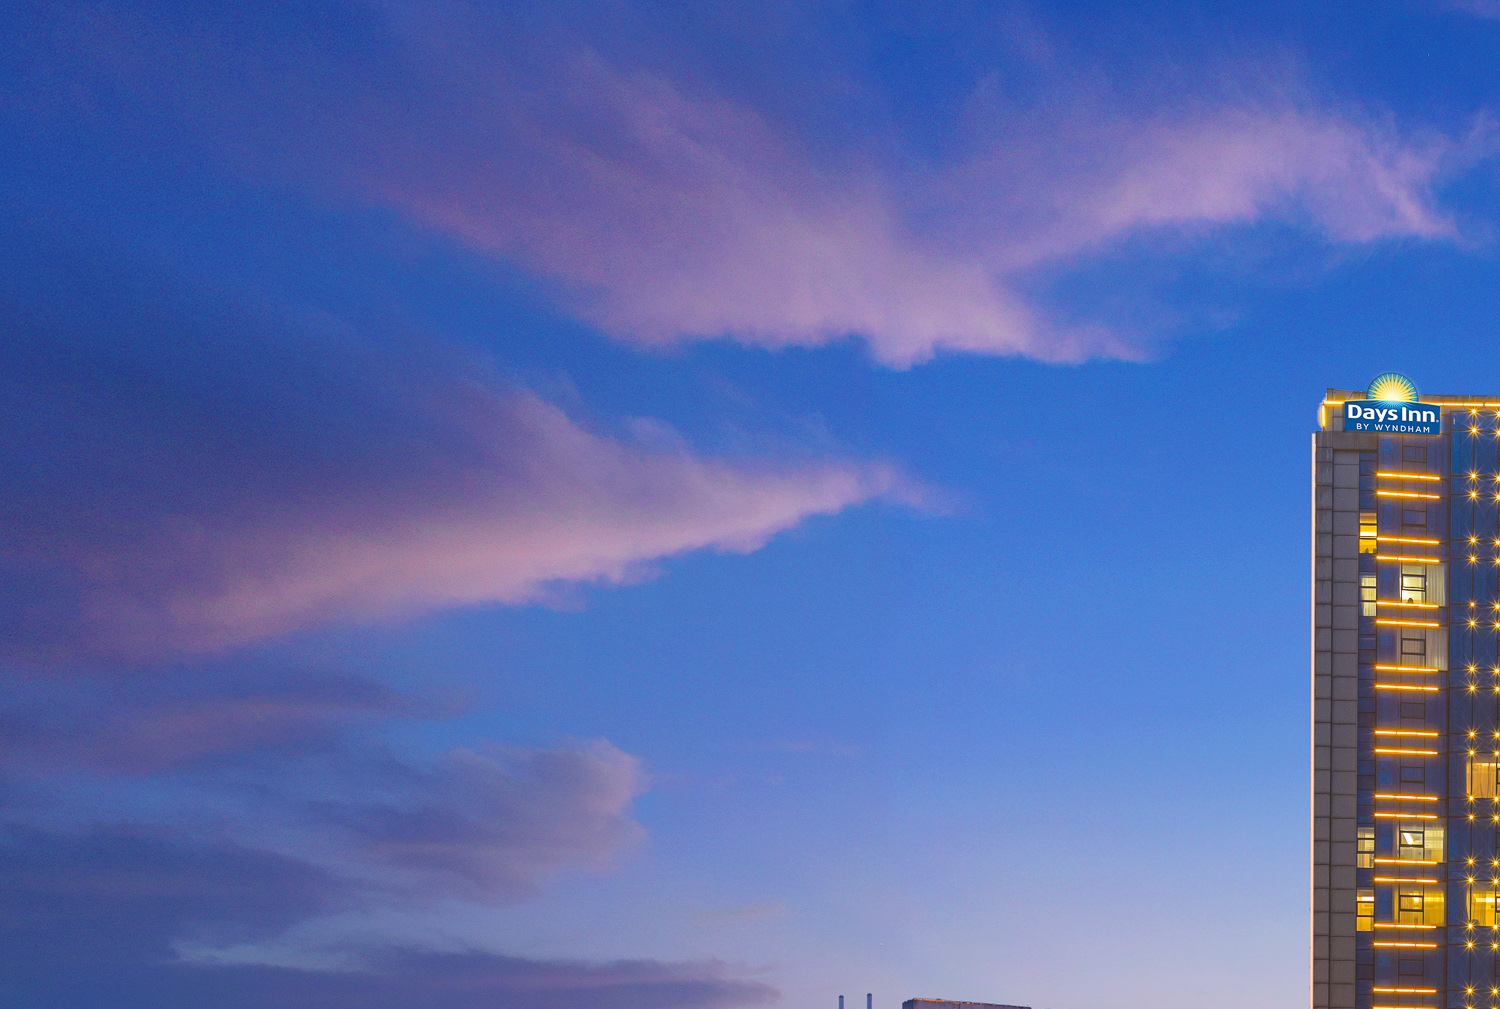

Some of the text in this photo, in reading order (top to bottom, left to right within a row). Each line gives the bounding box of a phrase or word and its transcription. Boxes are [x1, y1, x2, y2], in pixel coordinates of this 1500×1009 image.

[1347, 404, 1436, 423] Days Inn
[1374, 423, 1430, 433] WYNDHAM
